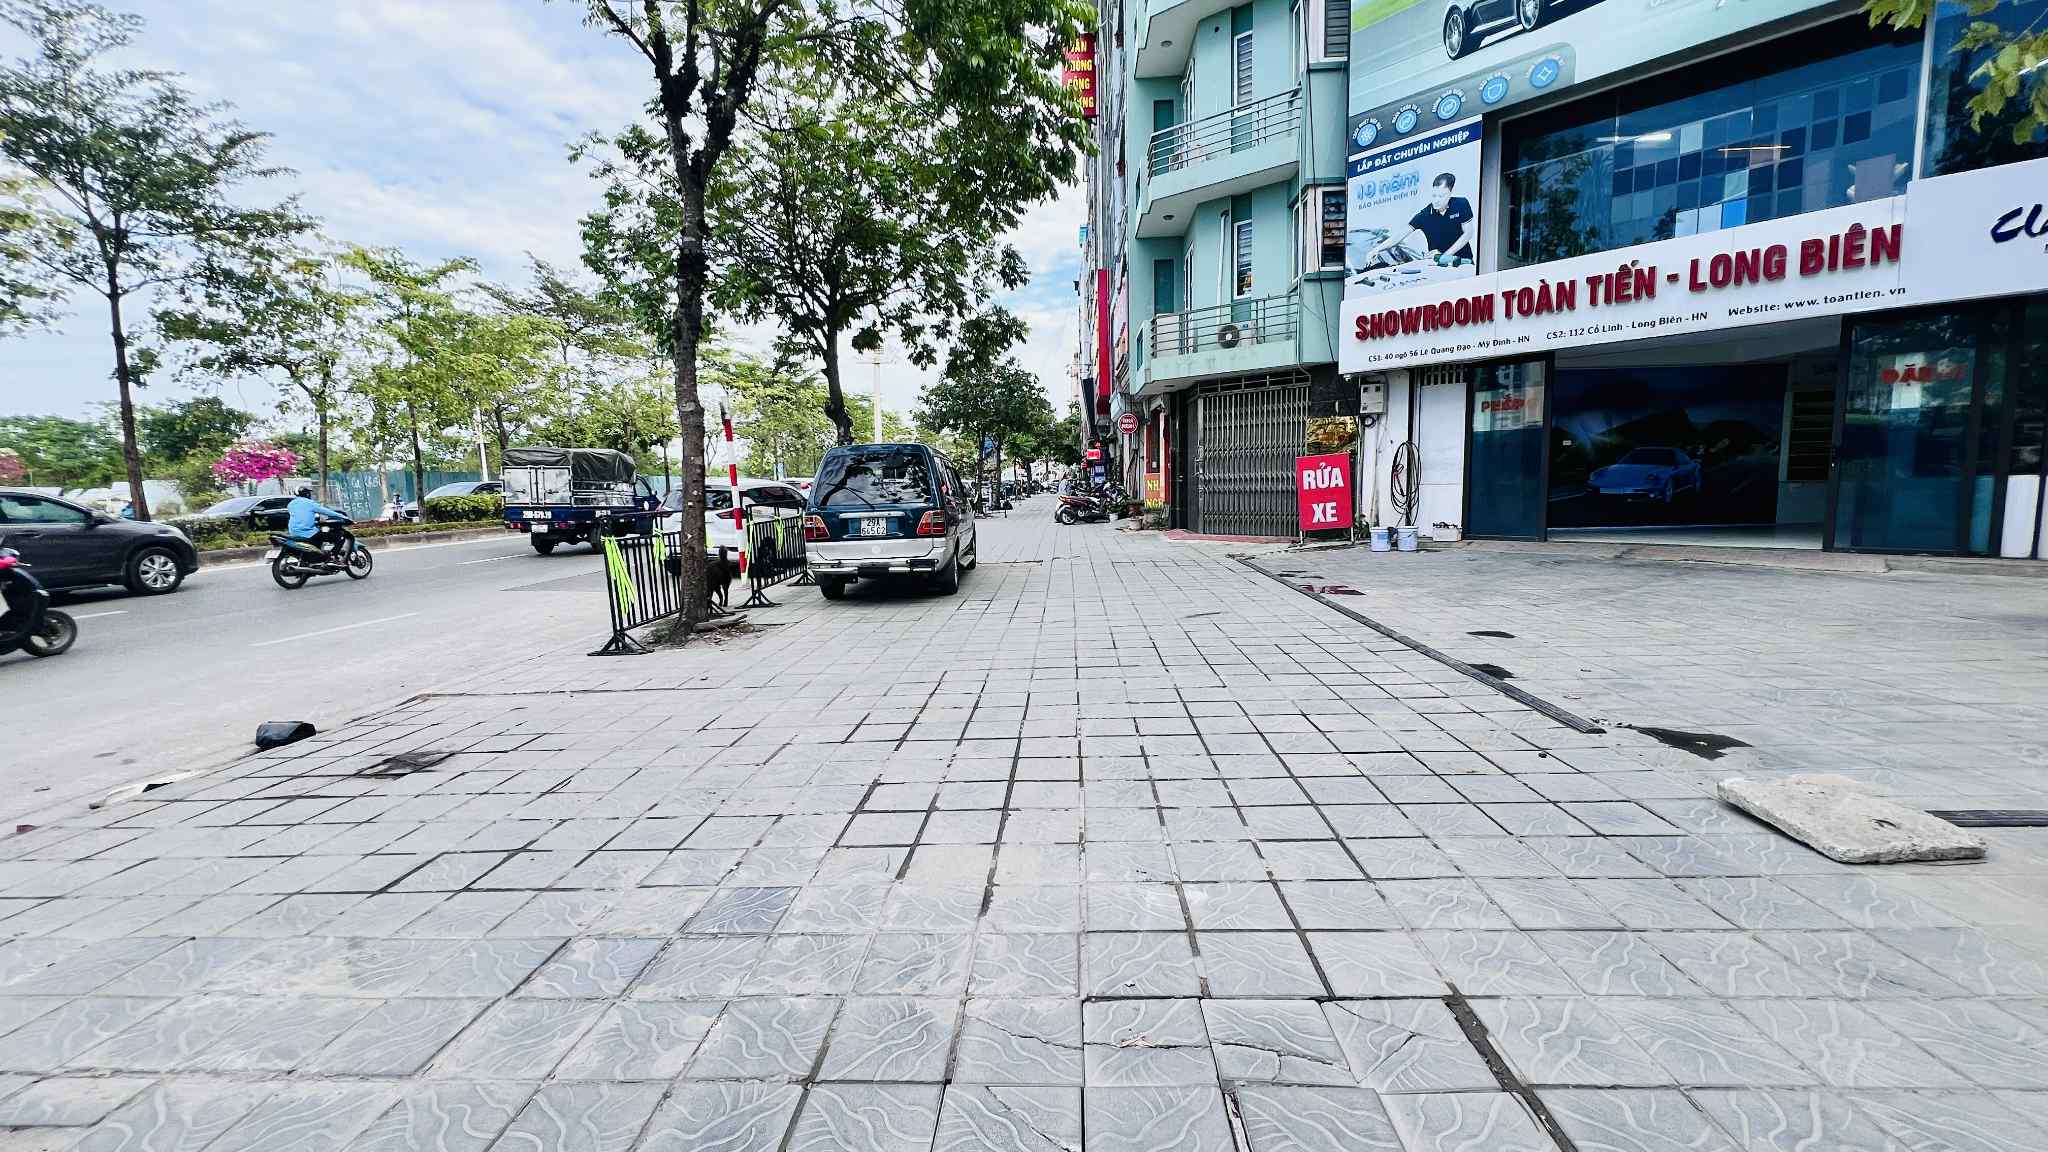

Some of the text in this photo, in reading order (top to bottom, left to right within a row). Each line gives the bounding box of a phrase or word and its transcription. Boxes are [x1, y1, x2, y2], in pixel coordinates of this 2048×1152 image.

[1357, 130, 1470, 172] LẮP ĐẶT CHUYÊN NGHIỆP
[1355, 293, 1495, 341] SHOWROOM
[1501, 278, 1578, 319] TOÀN
[1585, 259, 1657, 307] TIẾN
[1688, 244, 1788, 292] LONG
[1799, 222, 1903, 276] BIÊN
[1728, 303, 1780, 317] Website:
[1546, 330, 1567, 340] CS2:
[1568, 327, 1585, 337] 112
[1602, 323, 1623, 332] Linh
[1631, 319, 1656, 329] Long
[1691, 311, 1708, 321] HN
[1384, 352, 1394, 360] 40
[1409, 349, 1418, 357] 56
[1430, 345, 1454, 356] Quang
[1517, 335, 1530, 344] HN
[1302, 462, 1345, 490] RỬA
[1311, 501, 1338, 523] XE
